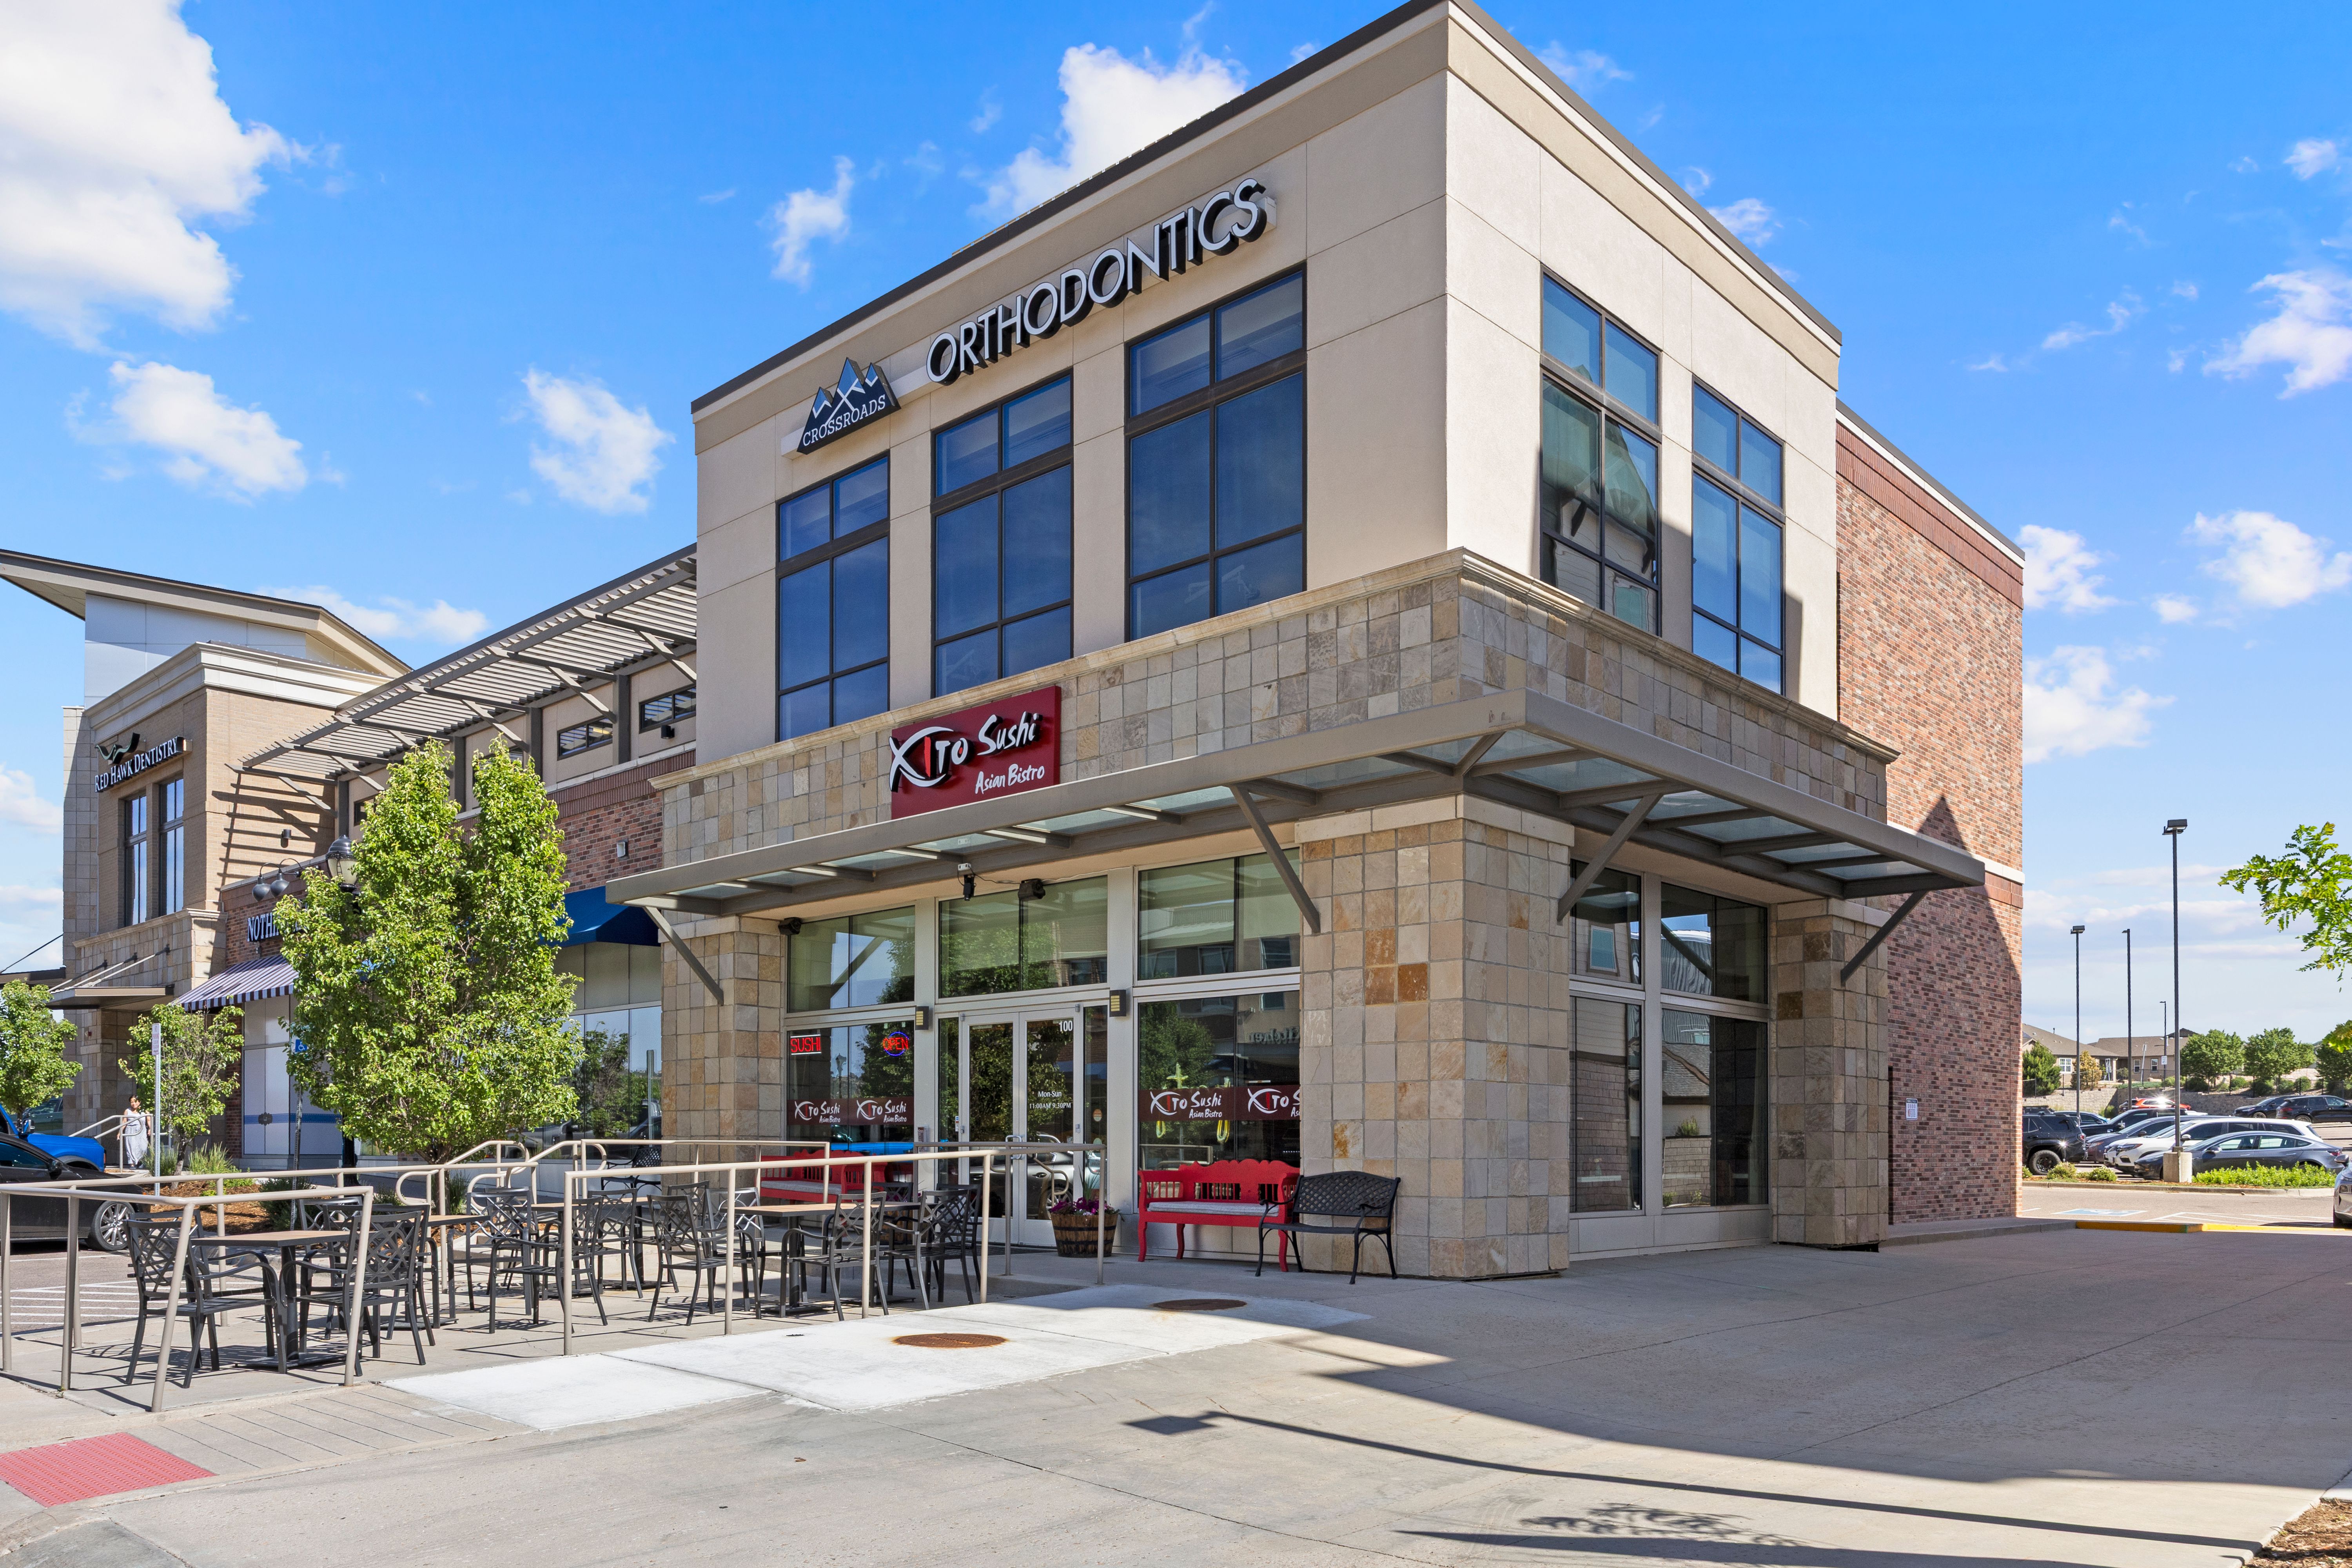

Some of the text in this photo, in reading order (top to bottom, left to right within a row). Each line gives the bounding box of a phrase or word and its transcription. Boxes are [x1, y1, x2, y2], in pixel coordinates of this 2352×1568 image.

[926, 178, 1264, 383] ORTHODONTICS
[803, 394, 885, 446] CROSSROADS
[977, 711, 1041, 755] Sushi
[95, 736, 178, 792] RED HAWK DENTISTRY
[975, 764, 1045, 794] Asian Bistro
[1059, 1020, 1073, 1032] 100
[790, 1037, 820, 1053] SUSHI
[882, 1037, 909, 1051] OPEN
[885, 1100, 906, 1113] Sushi
[1191, 1091, 1221, 1107] Sushi
[820, 1101, 840, 1114] Sushi
[1189, 1108, 1222, 1119] Asian Bistro
